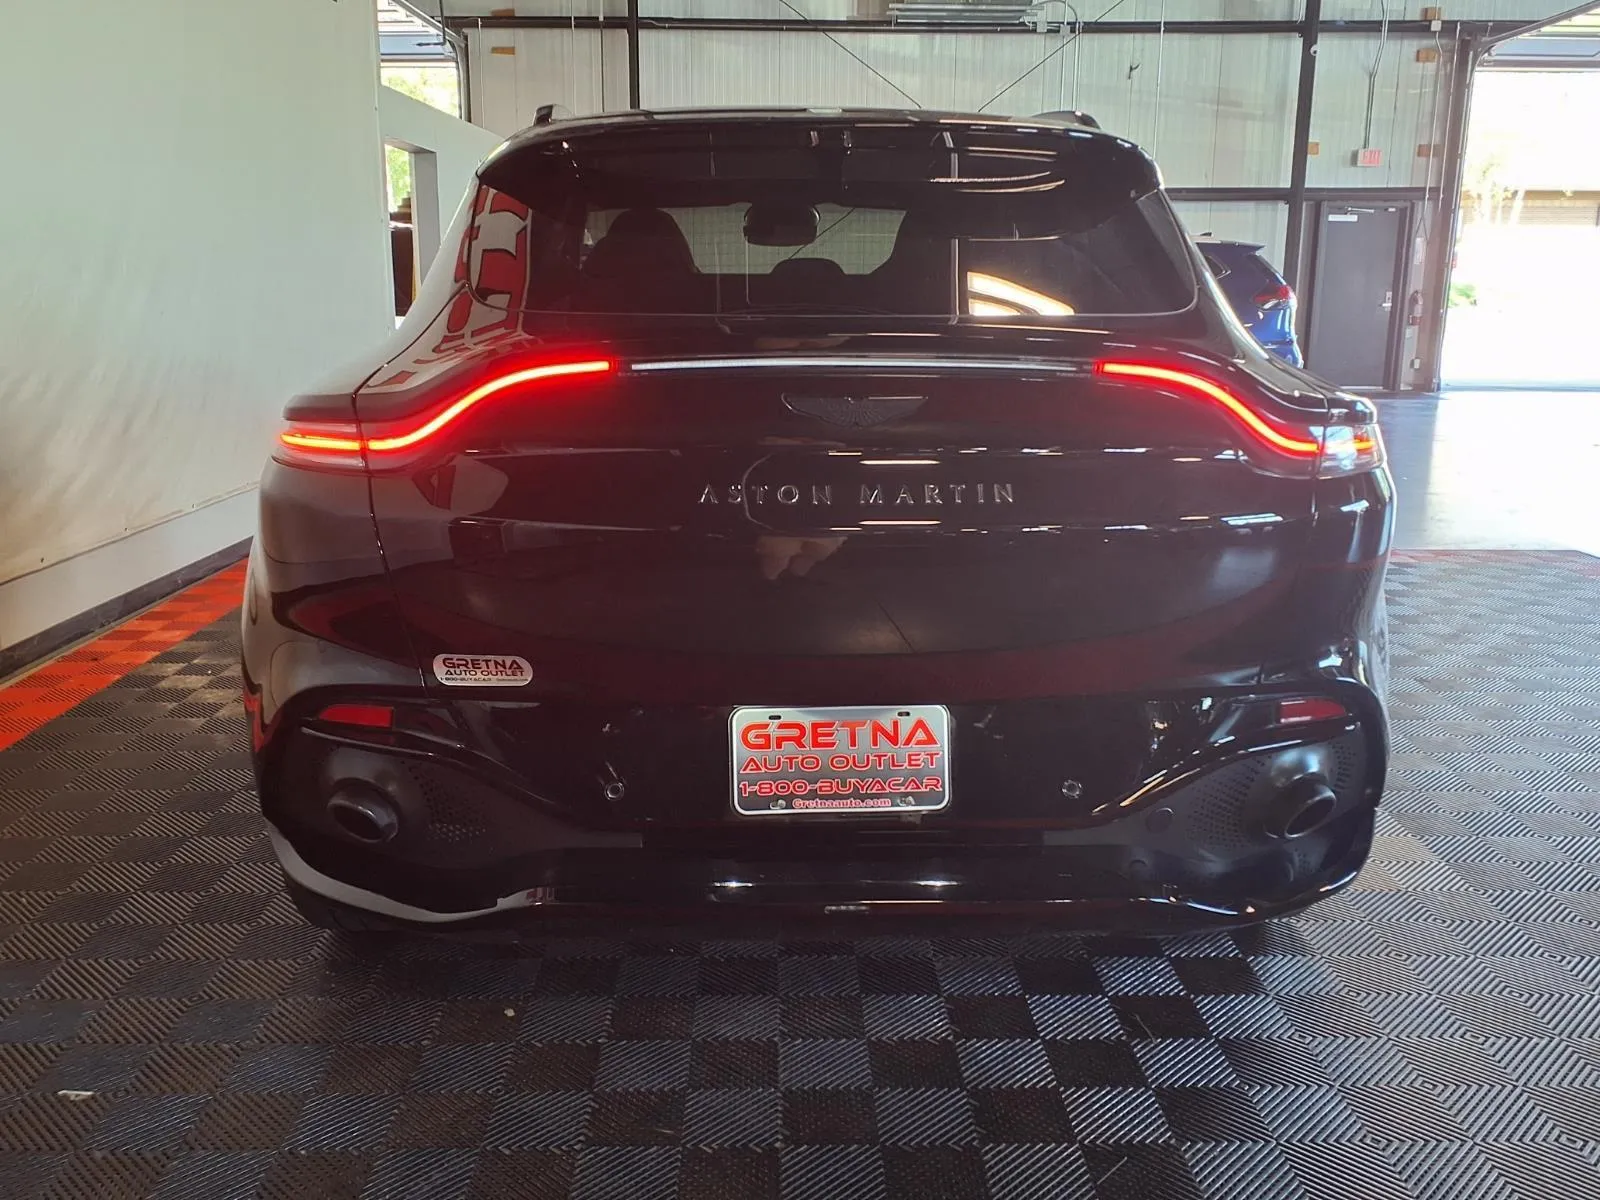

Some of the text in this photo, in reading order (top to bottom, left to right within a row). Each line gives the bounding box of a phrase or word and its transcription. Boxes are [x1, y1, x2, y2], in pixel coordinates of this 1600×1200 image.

[698, 483, 1014, 505] ASTON MARTIN
[442, 658, 523, 670] GRETNA
[740, 718, 940, 751] GRETNA
[740, 752, 942, 774] AUTO OUTLET
[739, 777, 942, 796] 1-800-BUYACAR
[792, 798, 892, 808] Gretnaauto.com
